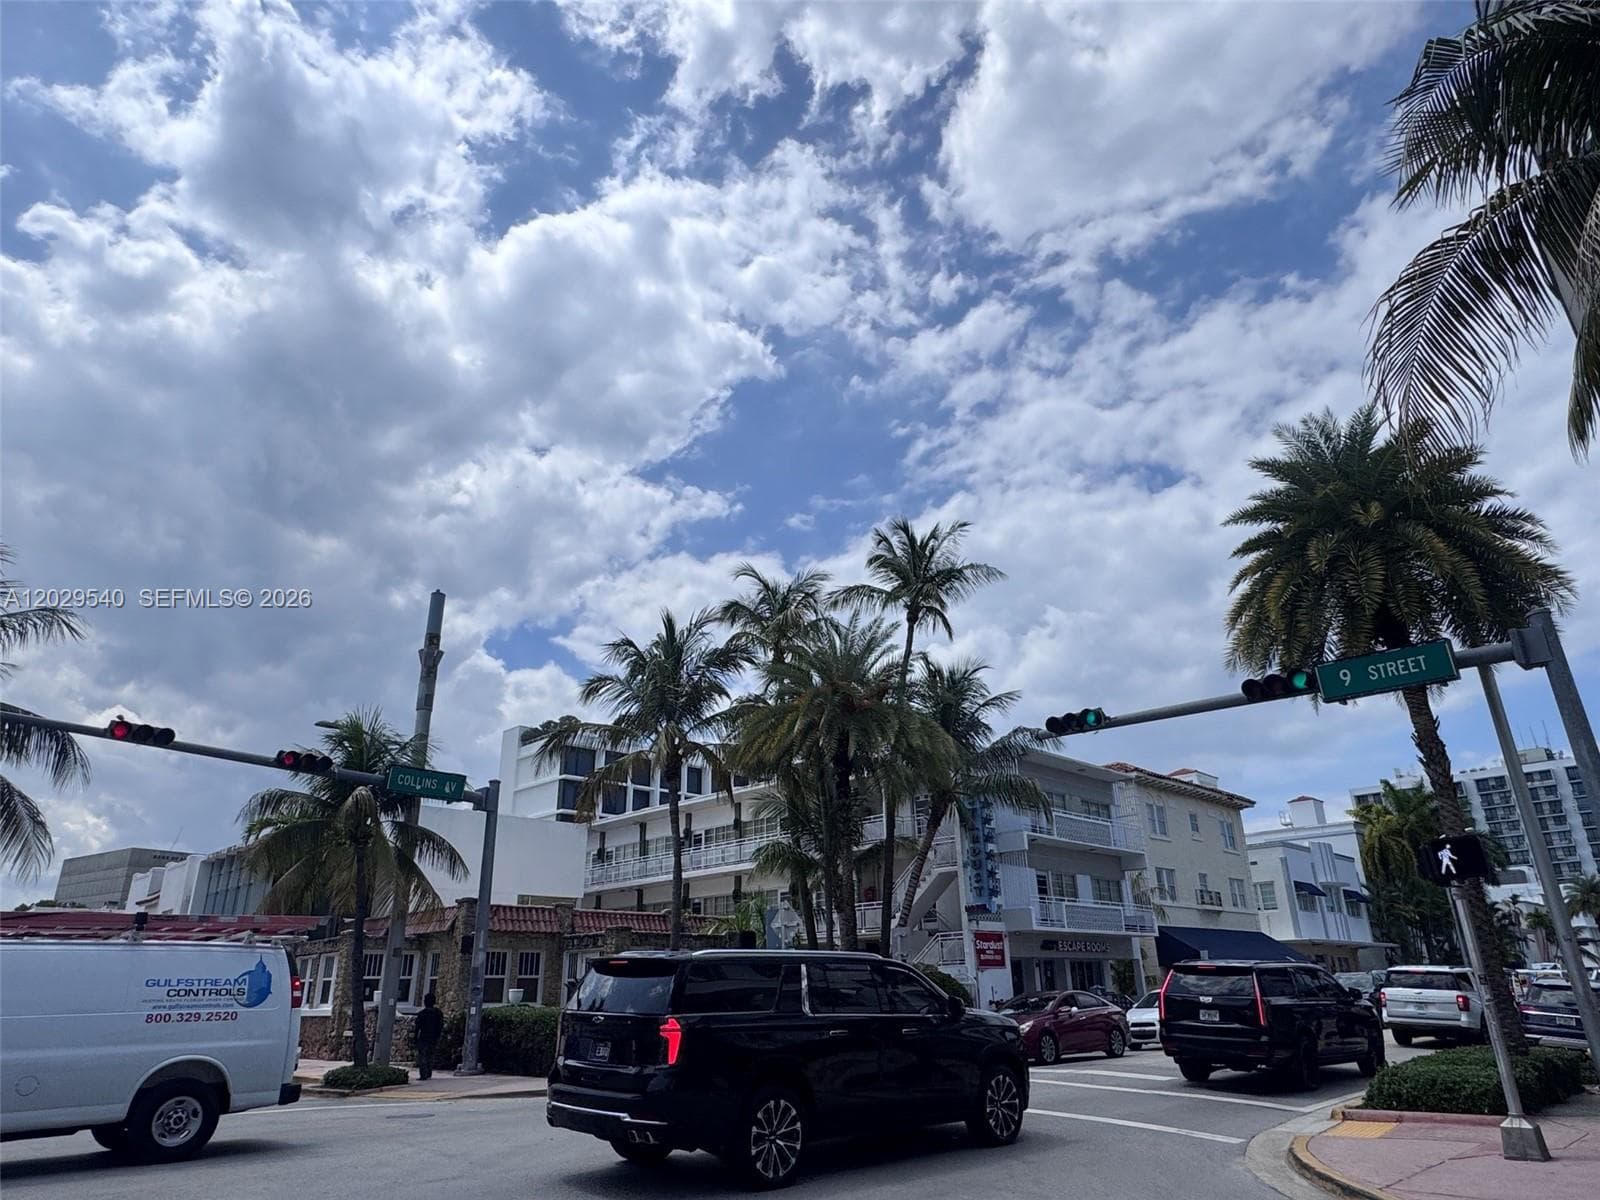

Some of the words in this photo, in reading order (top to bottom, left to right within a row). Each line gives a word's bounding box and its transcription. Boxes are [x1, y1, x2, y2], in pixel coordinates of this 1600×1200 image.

[1339, 669, 1351, 686] 9
[1367, 655, 1426, 681] STREET
[397, 774, 438, 790] COLLINS
[444, 781, 457, 793] AV
[1058, 940, 1086, 952] ESCAPE
[1086, 942, 1111, 953] ROOMS
[145, 978, 247, 988] GULFSTREAM
[166, 988, 246, 998] CONTROLS
[145, 1011, 239, 1024] 800.329.2520
